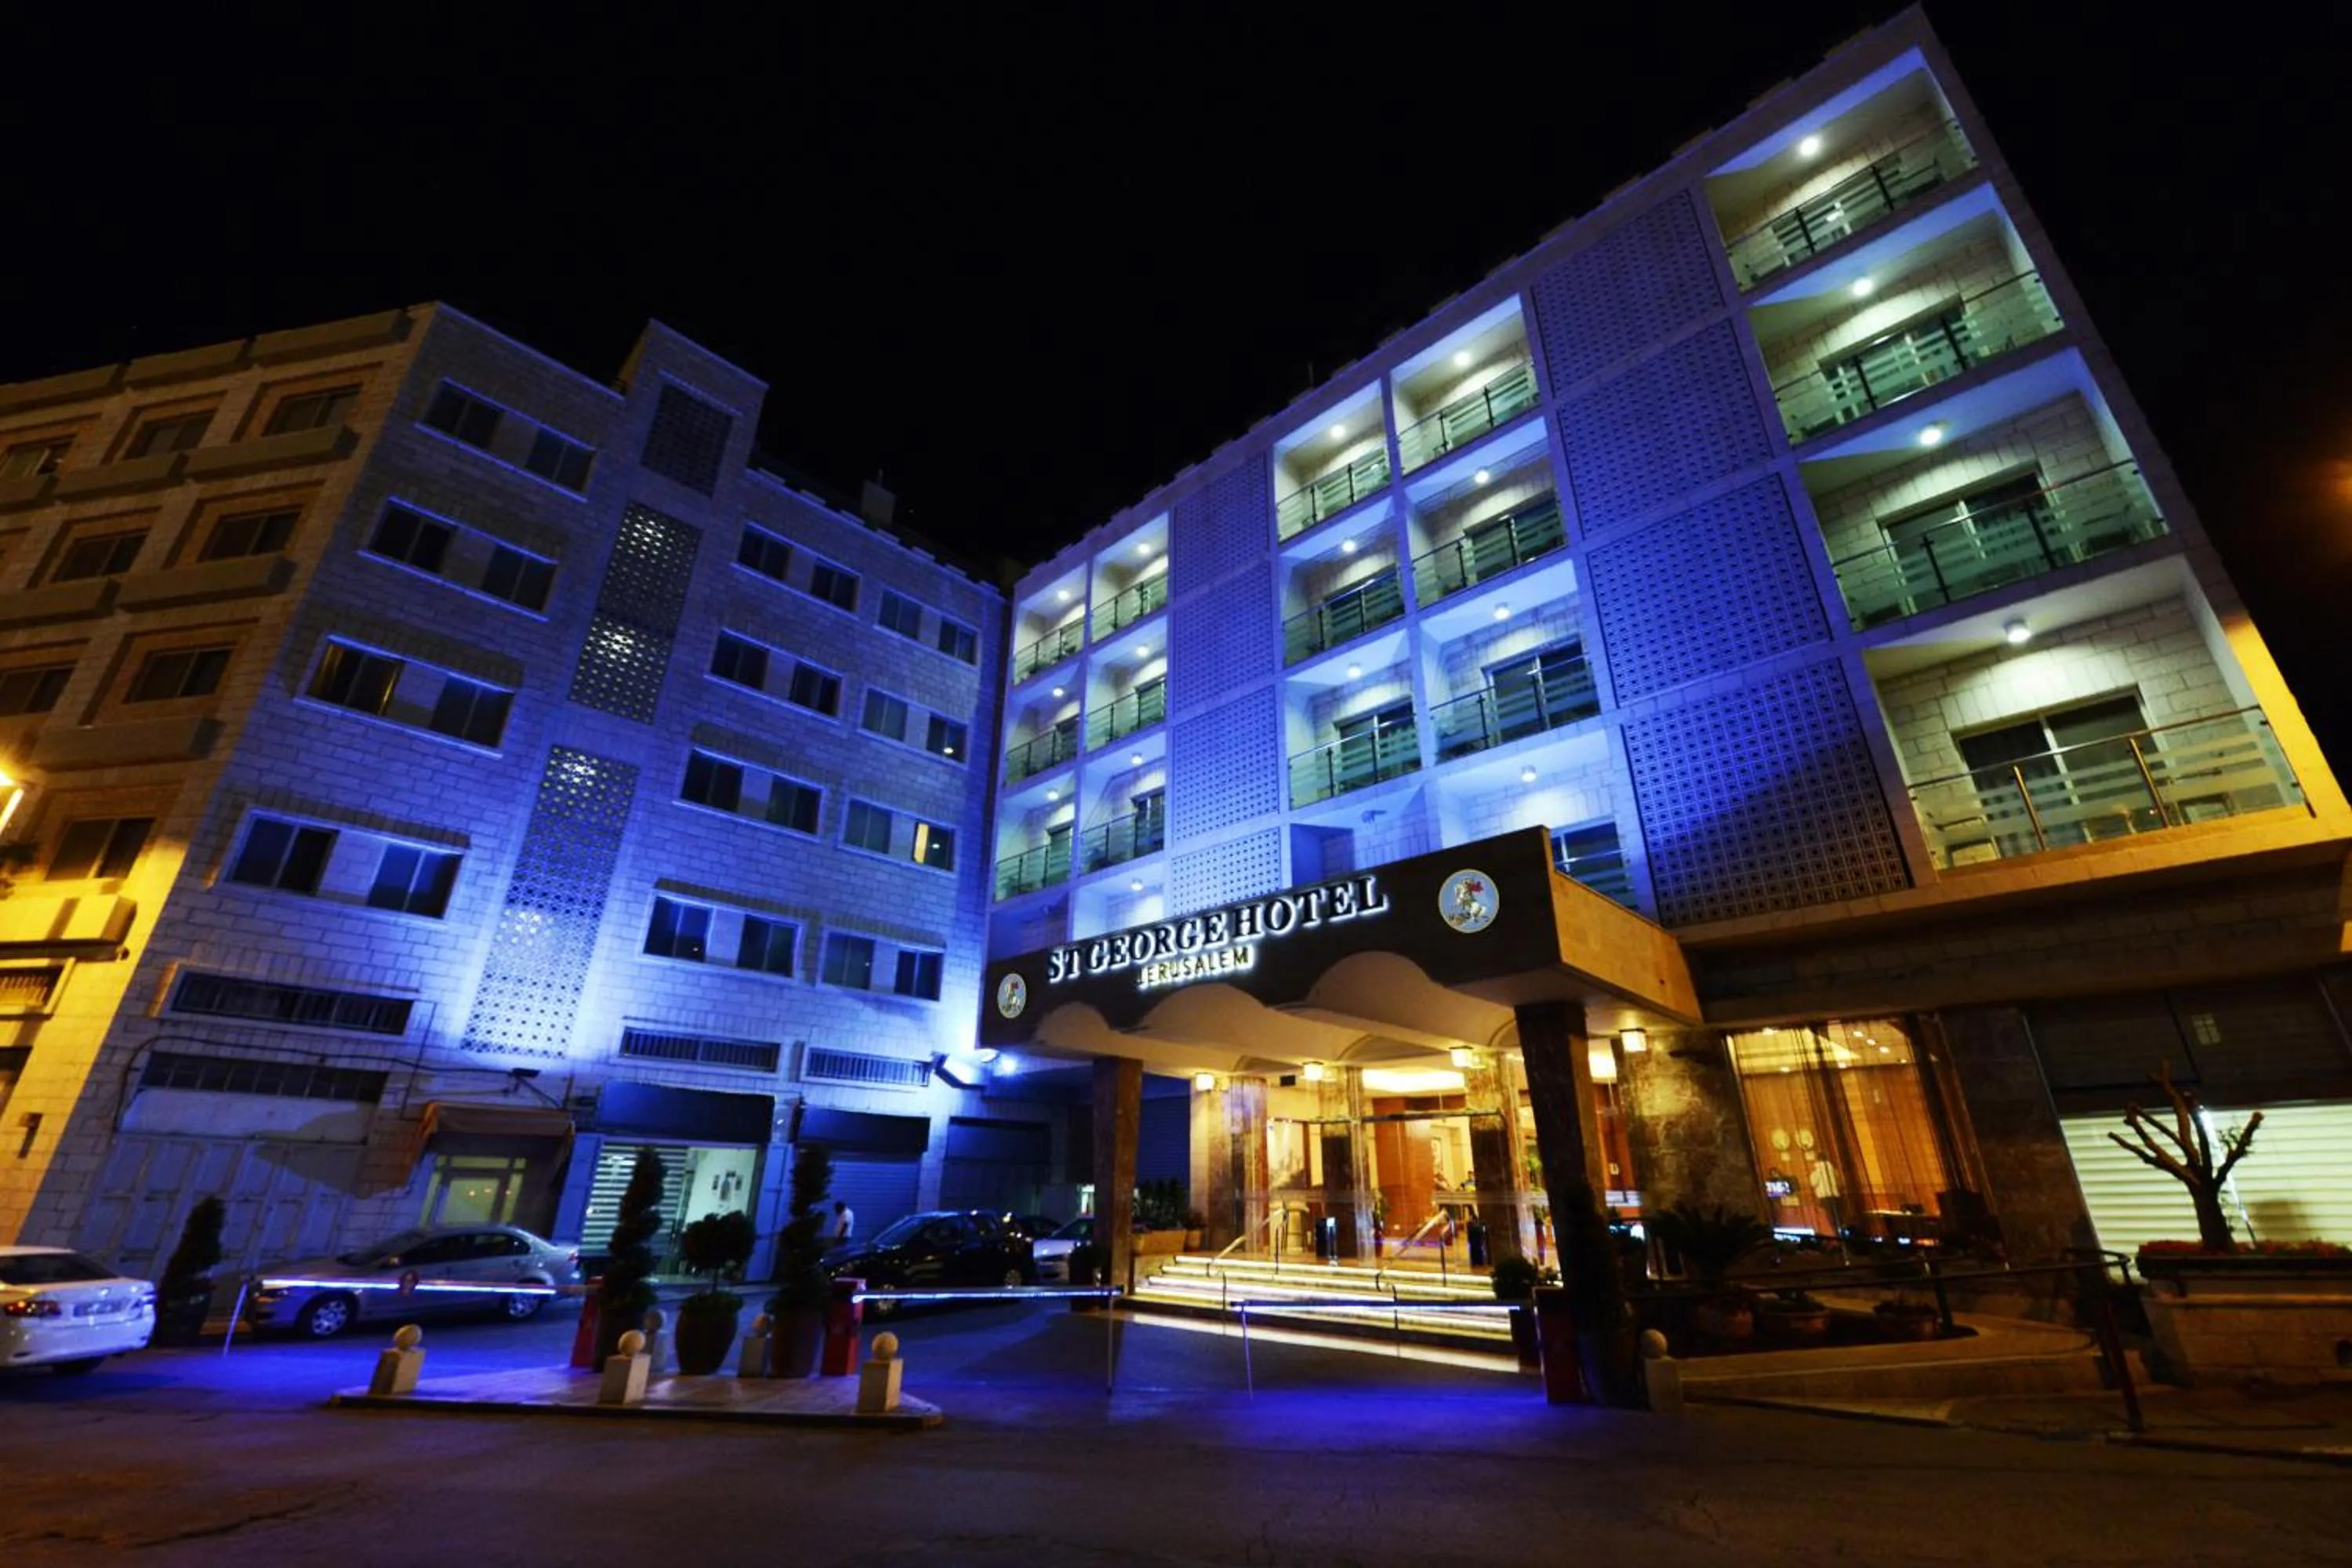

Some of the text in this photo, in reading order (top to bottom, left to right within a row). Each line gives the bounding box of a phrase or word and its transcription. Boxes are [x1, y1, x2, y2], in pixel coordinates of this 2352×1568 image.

[1046, 876, 1388, 983] ST GEORGE HOTEL
[1138, 946, 1255, 989] JERUSALEM
